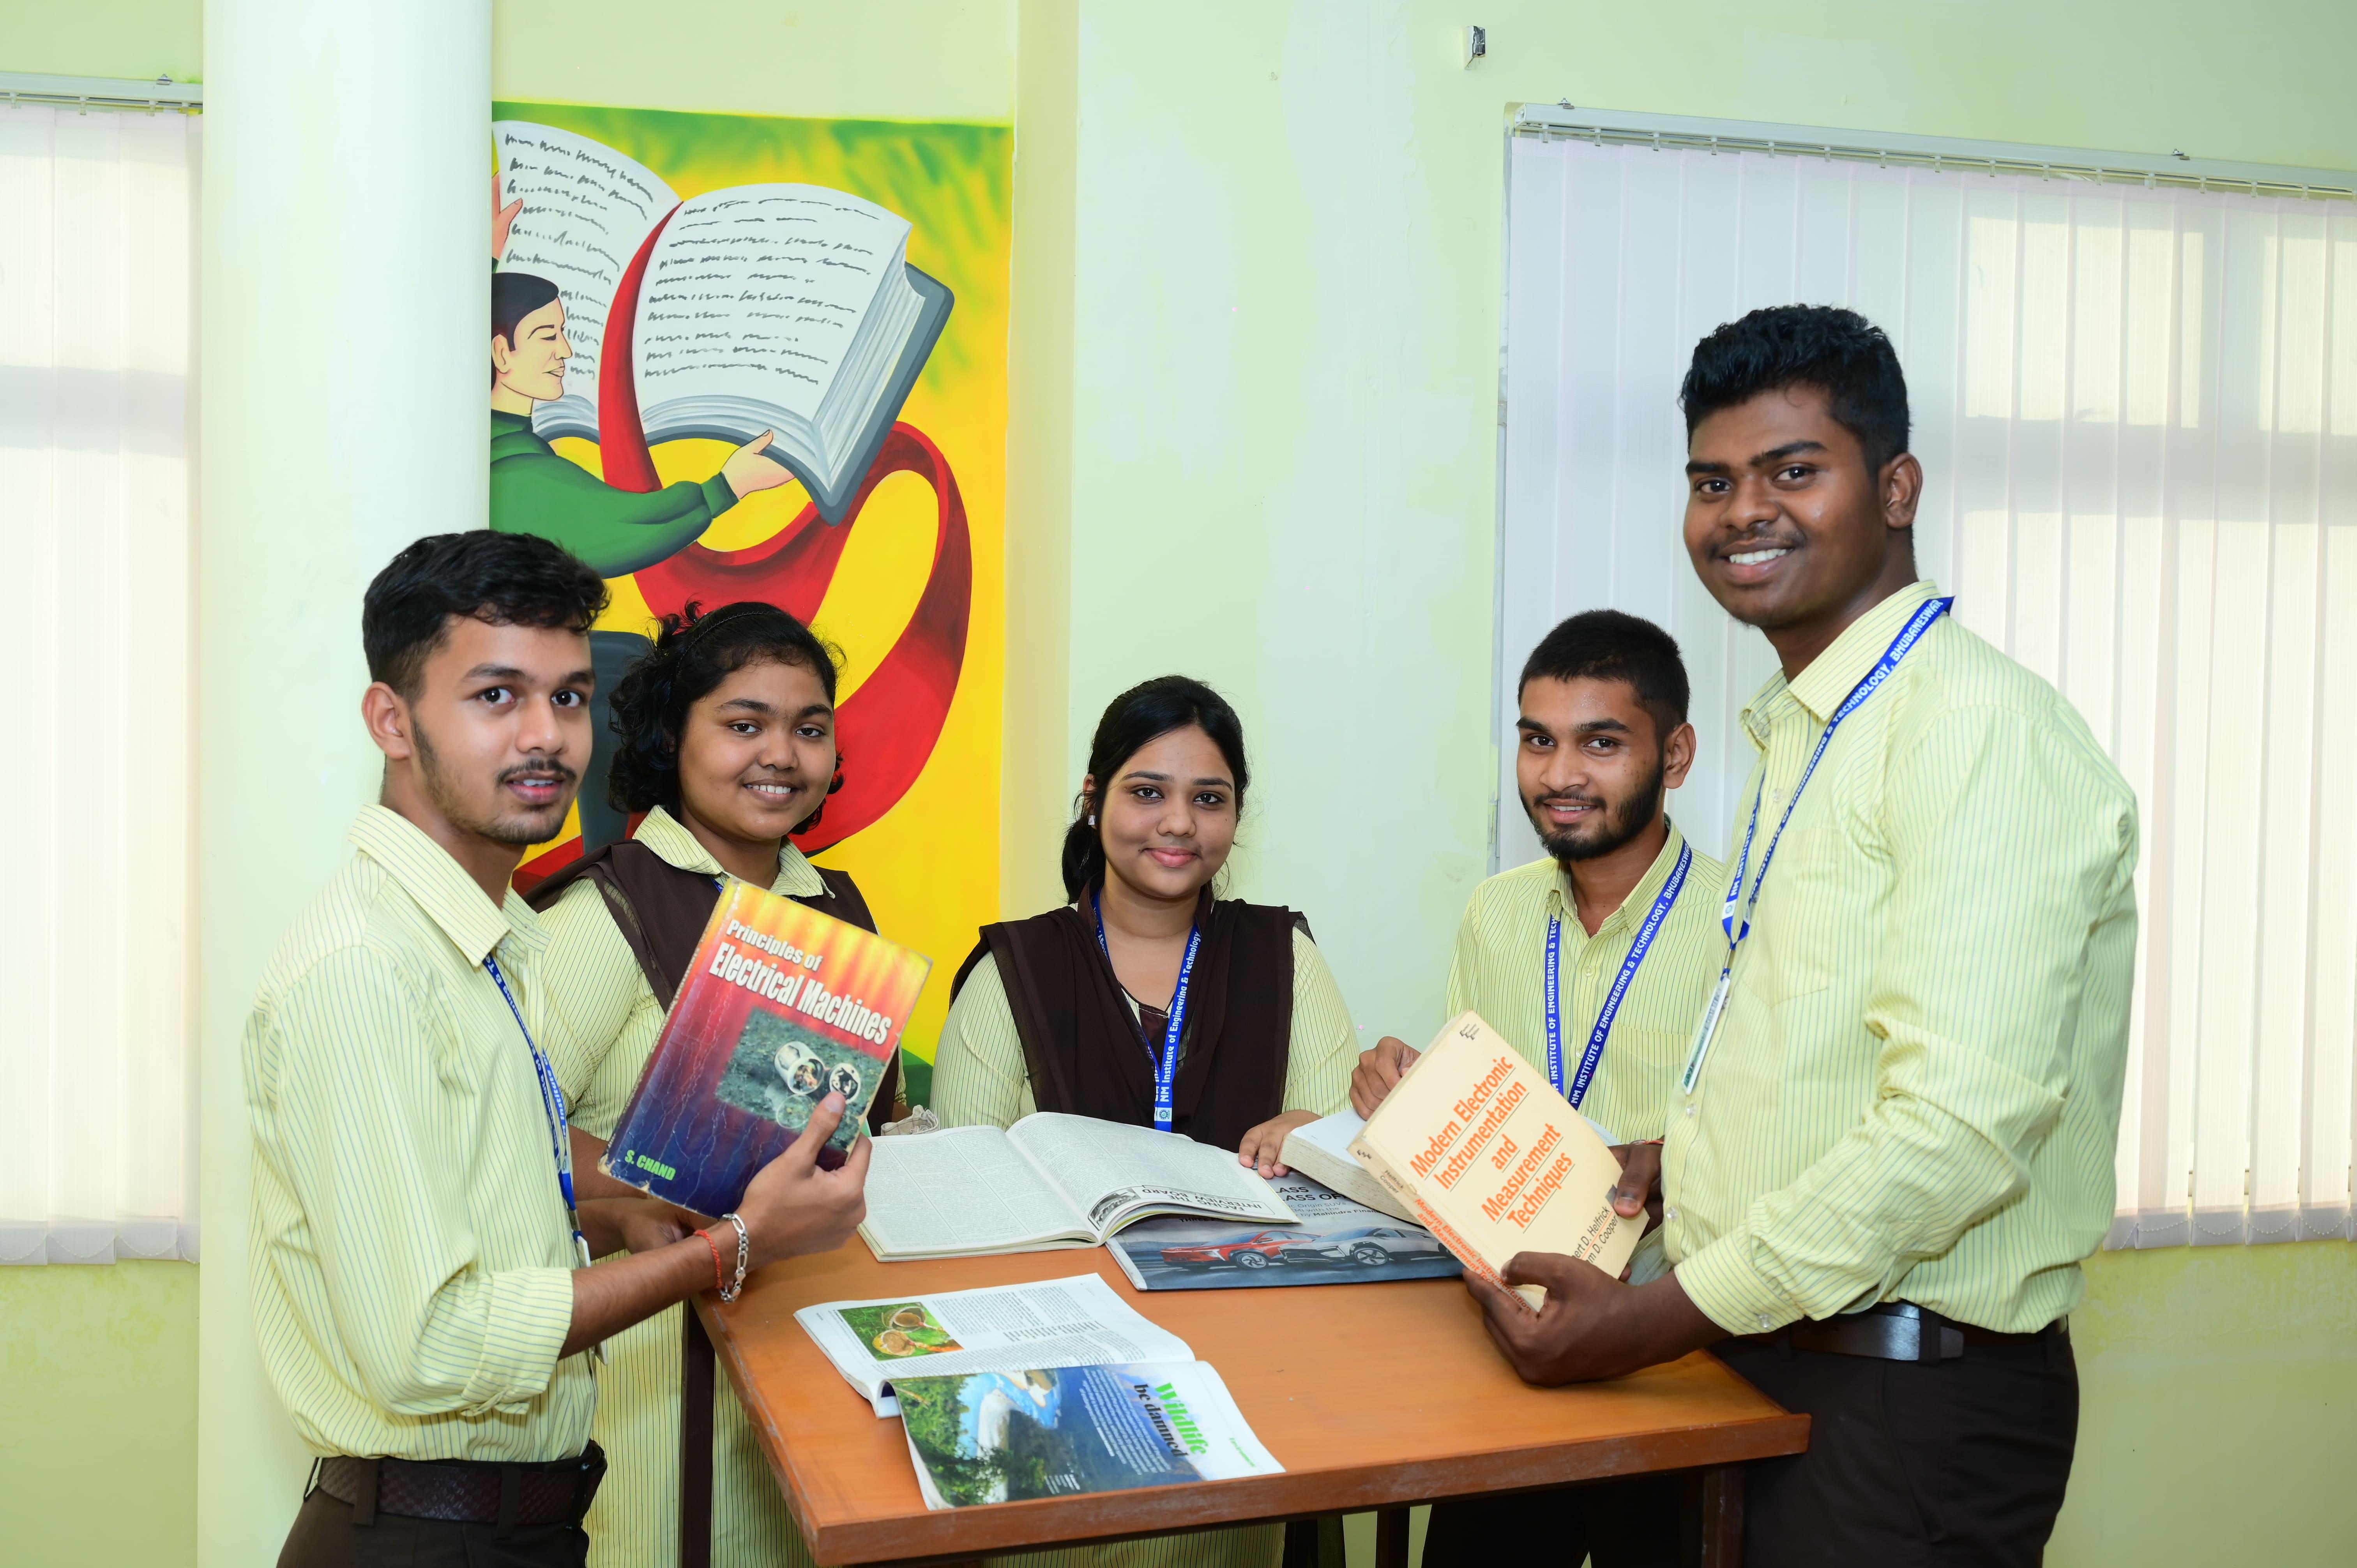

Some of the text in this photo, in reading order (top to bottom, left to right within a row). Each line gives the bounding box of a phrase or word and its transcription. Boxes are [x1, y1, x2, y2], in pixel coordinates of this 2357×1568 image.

[1790, 736, 1827, 807] ENGINEERING
[1889, 599, 1944, 662] BHUBANESWAR
[1730, 880, 1740, 896] NM
[1737, 827, 1752, 879] INSTITUTE
[726, 919, 823, 971] Principles of
[1182, 932, 1201, 975] Technology
[496, 973, 502, 984] &
[709, 941, 892, 1045] Electrical Machines
[1168, 1034, 1176, 1043] of
[1549, 1017, 1556, 1029] OF
[1571, 1090, 1581, 1104] NM
[1576, 1044, 1599, 1088] INSTITUTE
[1594, 1029, 1604, 1042] OF
[1599, 969, 1631, 1029] ENGINEERING
[535, 1058, 541, 1071] of
[1162, 1046, 1174, 1083] Institute
[1547, 1032, 1558, 1080] INSTITUTE
[547, 1069, 565, 1120] Institute
[1160, 1086, 1169, 1102] NM
[1410, 1056, 1513, 1178] Modern Electronic
[1434, 1081, 1527, 1190] Instrumentation
[625, 1150, 676, 1181] S. CHAND
[1481, 1123, 1561, 1222] Measurement
[1491, 1134, 1518, 1170] and
[1142, 1188, 1188, 1197] BOARD
[1194, 1195, 1262, 1209] INTERVIEW
[1197, 1199, 1245, 1211] FACING
[1380, 1176, 1399, 1193] Cooper
[1507, 1152, 1573, 1229] Techniques
[1415, 1198, 1443, 1226] Modern
[1442, 1225, 1477, 1259] Electronic
[1417, 1213, 1432, 1227] and
[1431, 1225, 1481, 1272] Measurement
[1581, 1236, 1592, 1246] D.
[1587, 1206, 1610, 1237] Helfrick
[1592, 1243, 1603, 1254] D.
[1599, 1215, 1618, 1244] Cooper
[1134, 1384, 1189, 1457] be damned
[1155, 1382, 1209, 1455] Wildlife
